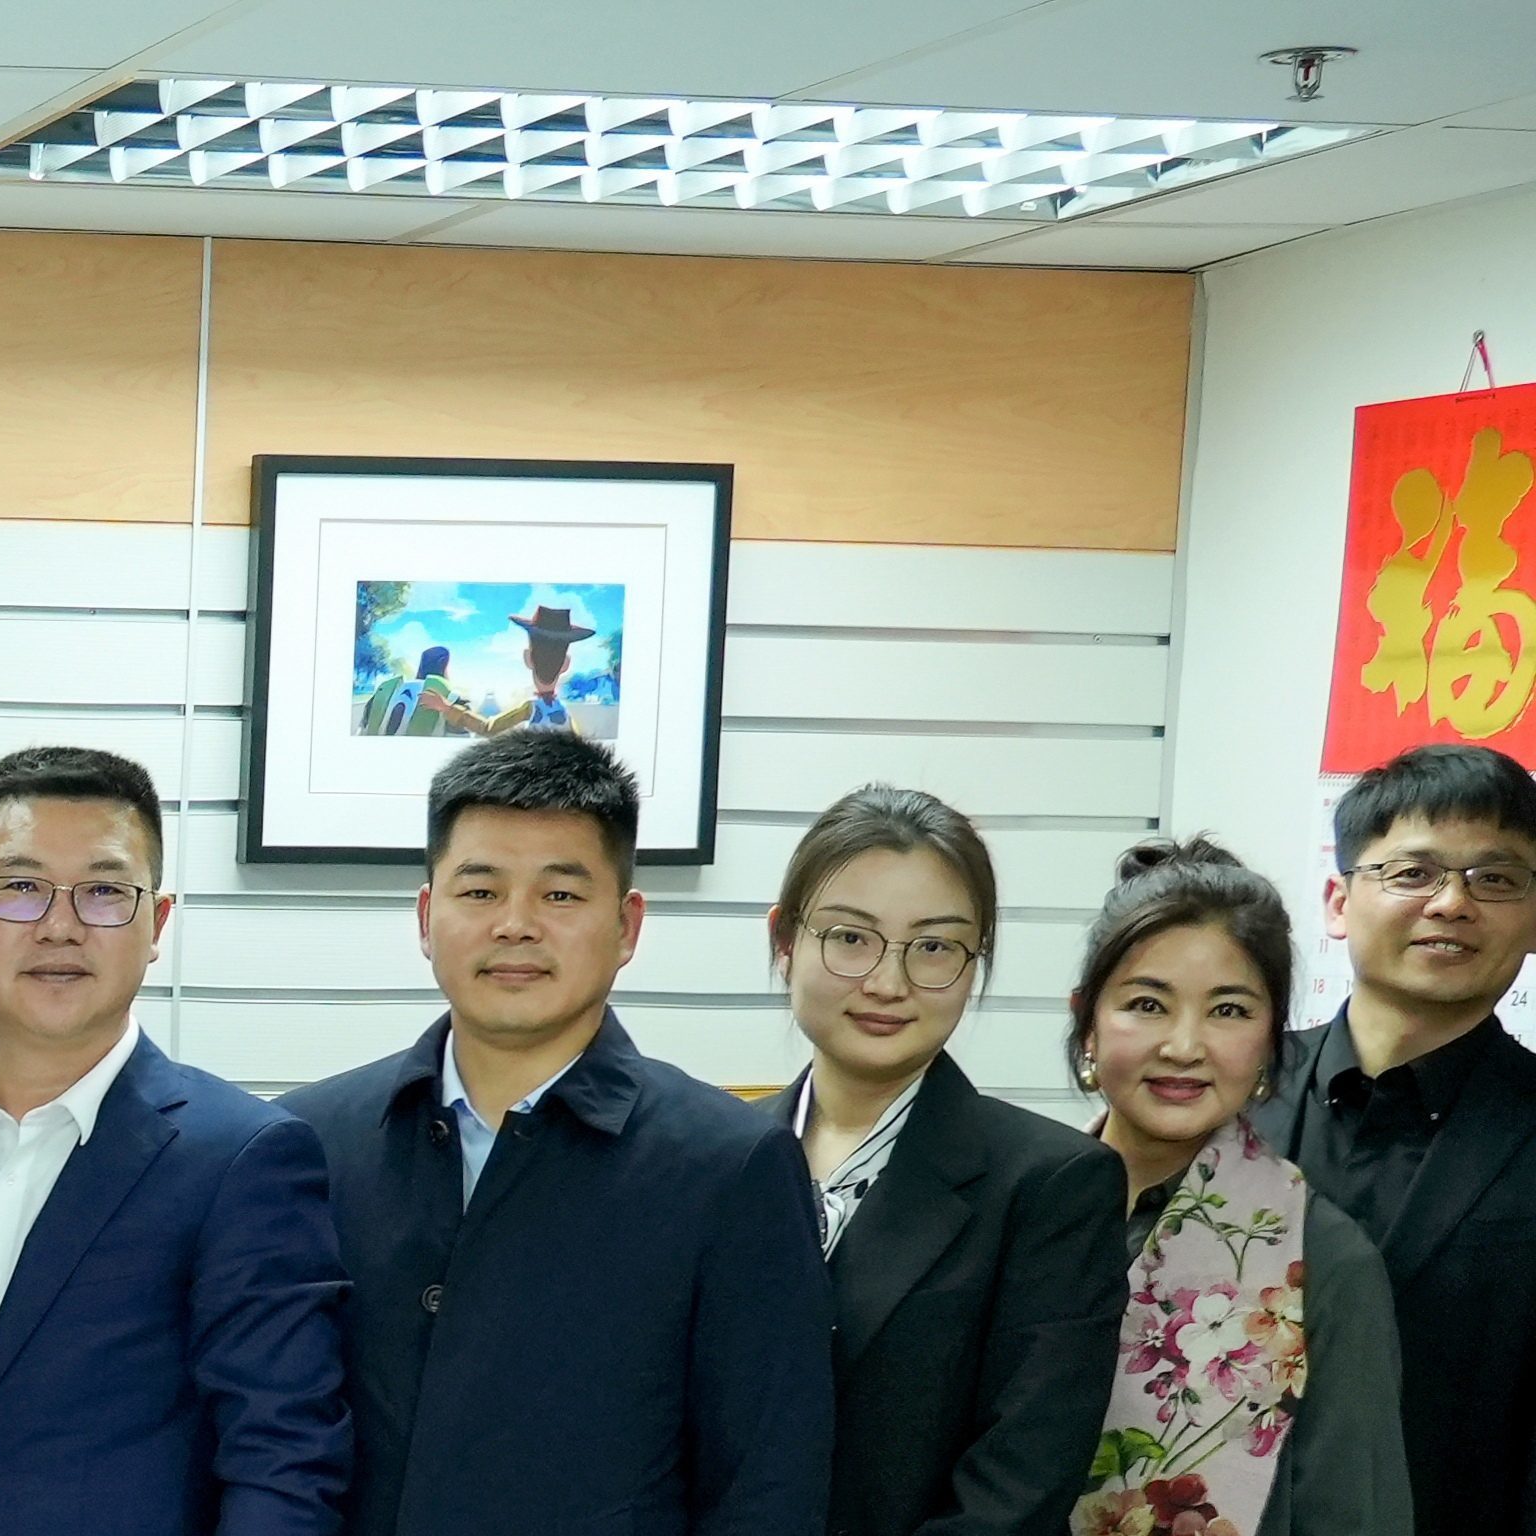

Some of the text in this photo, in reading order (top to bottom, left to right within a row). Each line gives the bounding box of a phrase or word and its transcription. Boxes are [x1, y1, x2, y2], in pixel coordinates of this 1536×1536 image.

[1361, 426, 1536, 740] 福
[1319, 939, 1329, 953] 11
[1312, 978, 1325, 993] 18
[1510, 991, 1528, 1006] 24
